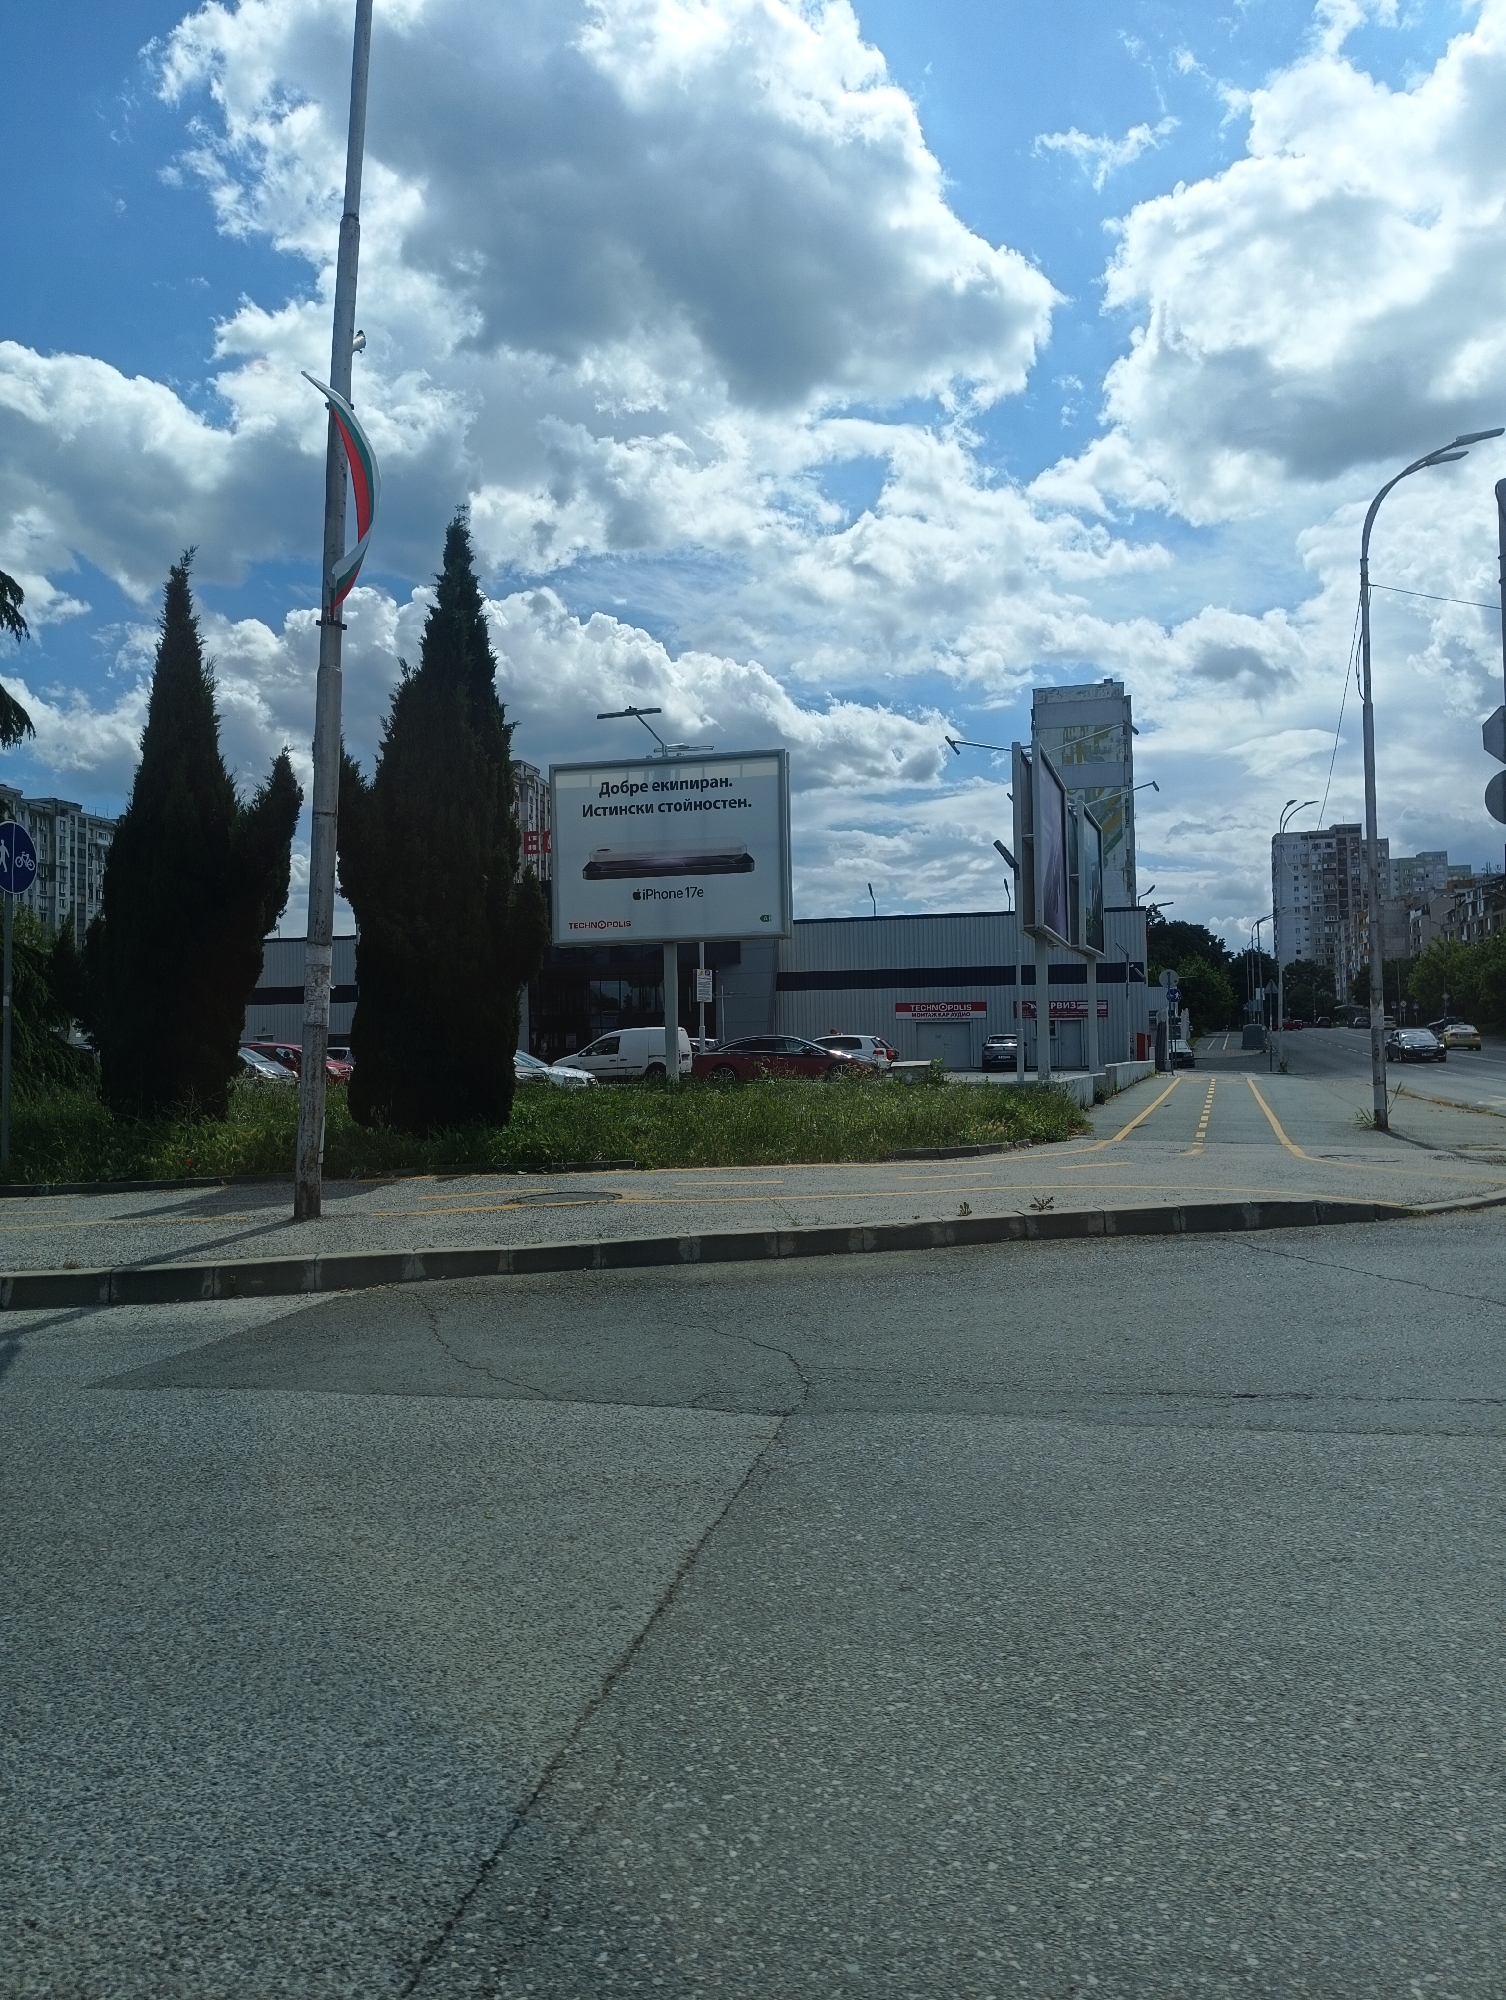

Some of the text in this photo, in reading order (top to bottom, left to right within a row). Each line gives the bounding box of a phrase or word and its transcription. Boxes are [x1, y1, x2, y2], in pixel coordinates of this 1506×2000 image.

[598, 777, 733, 798] Добре екипиран.
[582, 798, 752, 818] Истински стойностен.
[642, 887, 704, 901] iPhone 17e
[568, 920, 632, 930] TECHNOPOLIS
[910, 1002, 972, 1012] TECHNOPOLIS
[1048, 1001, 1077, 1010] РВИЗ
